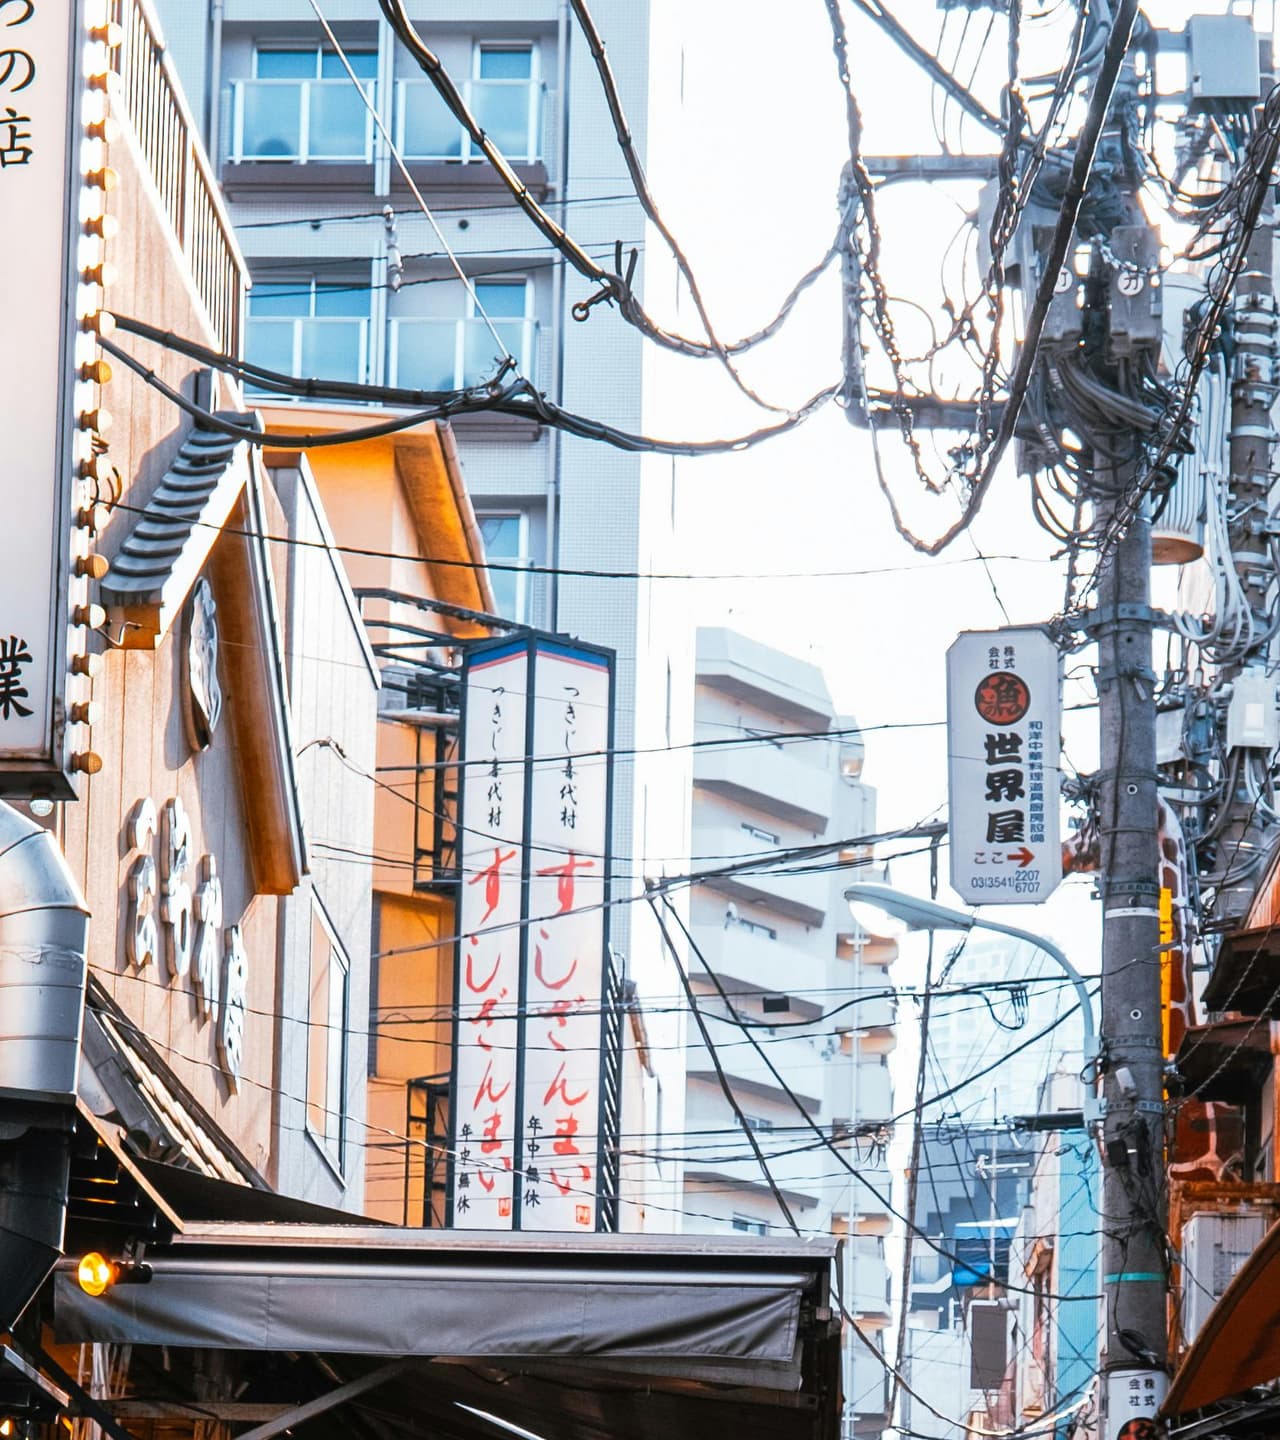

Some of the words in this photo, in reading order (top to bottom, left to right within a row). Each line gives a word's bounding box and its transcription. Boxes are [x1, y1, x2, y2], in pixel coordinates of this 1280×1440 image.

[984, 732, 1025, 844] 世界屋
[464, 847, 519, 1194] すしざんまい
[531, 848, 595, 1194] すしざんまい
[524, 1114, 543, 1209] 年中無休
